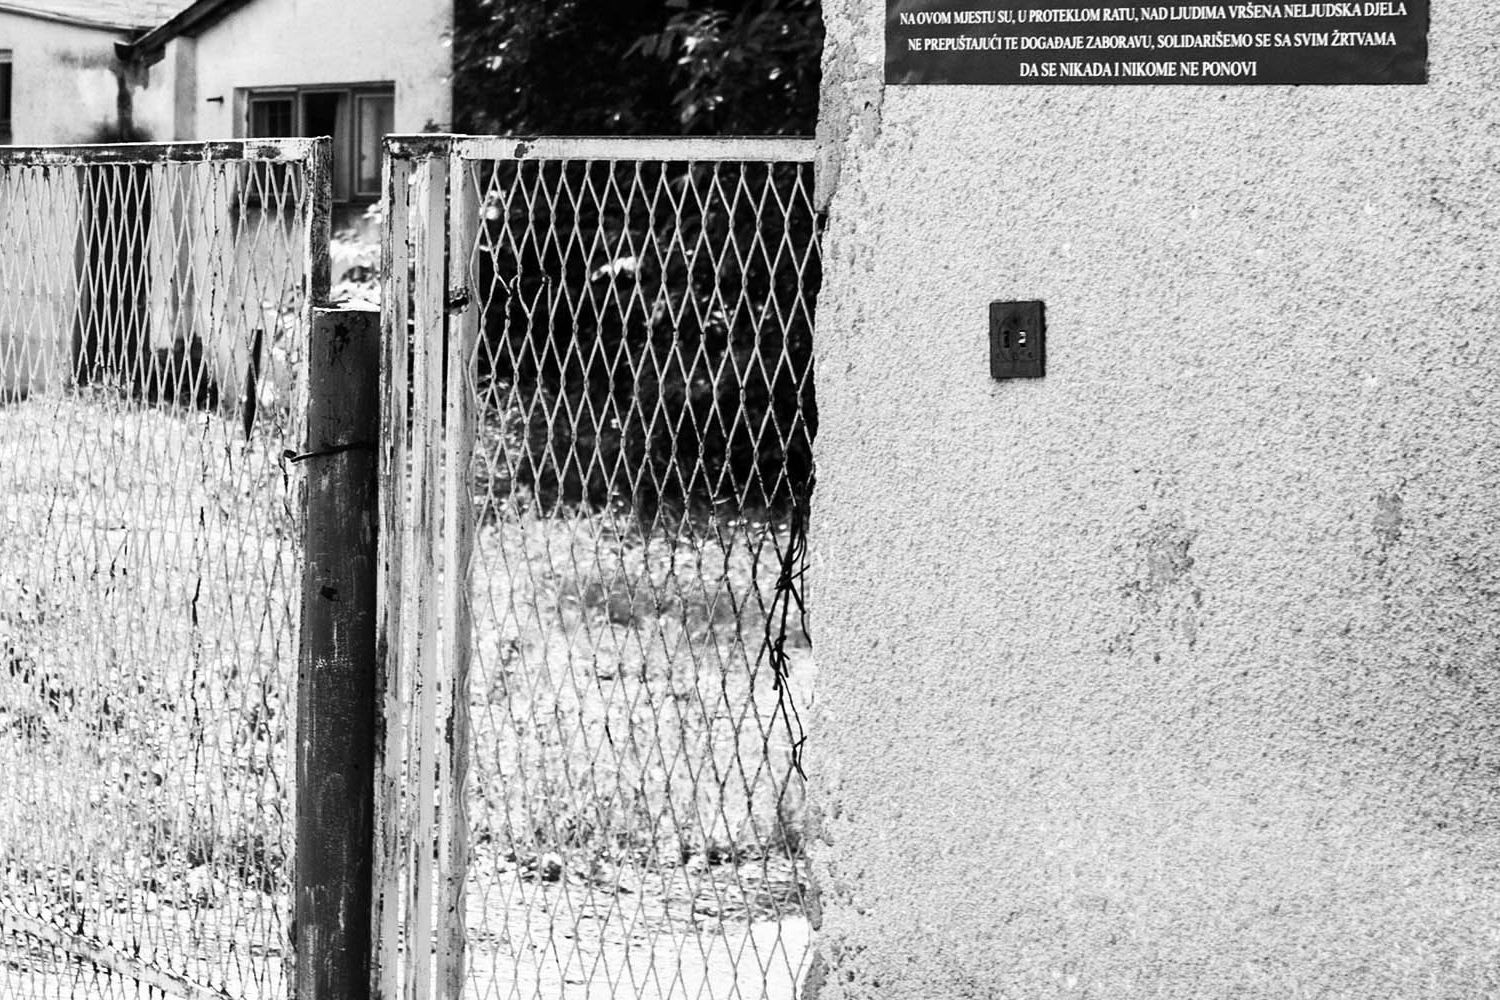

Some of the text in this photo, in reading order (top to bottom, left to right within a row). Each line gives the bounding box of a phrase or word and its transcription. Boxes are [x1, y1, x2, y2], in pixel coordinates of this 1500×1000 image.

[900, 12, 916, 25] NA
[917, 11, 951, 24] OVOM
[953, 10, 996, 24] MJESTU
[1018, 10, 1028, 22] U
[1029, 8, 1101, 22] PROTEKLOM
[1141, 7, 1168, 21] NAD
[1170, 5, 1226, 20] LJUDIMA
[1228, 2, 1282, 19] VRŠENA
[1284, 3, 1362, 18] NELJUDSKA
[1363, 2, 1407, 16] DJELA
[908, 38, 922, 51] NE
[924, 34, 1002, 50] PREPUŠTAJUĆI
[1004, 37, 1018, 50] TE
[1021, 36, 1084, 49] DOGAĐAJE
[1157, 31, 1253, 48] SOLIDARIŠEMO
[1255, 34, 1270, 47] SE
[1274, 33, 1292, 47] SA
[1294, 32, 1328, 46] SVIM
[1331, 29, 1396, 46] ŽRTVAMA
[1020, 61, 1257, 77] DA SE NIKADA I NIKOME NE PONOVI
